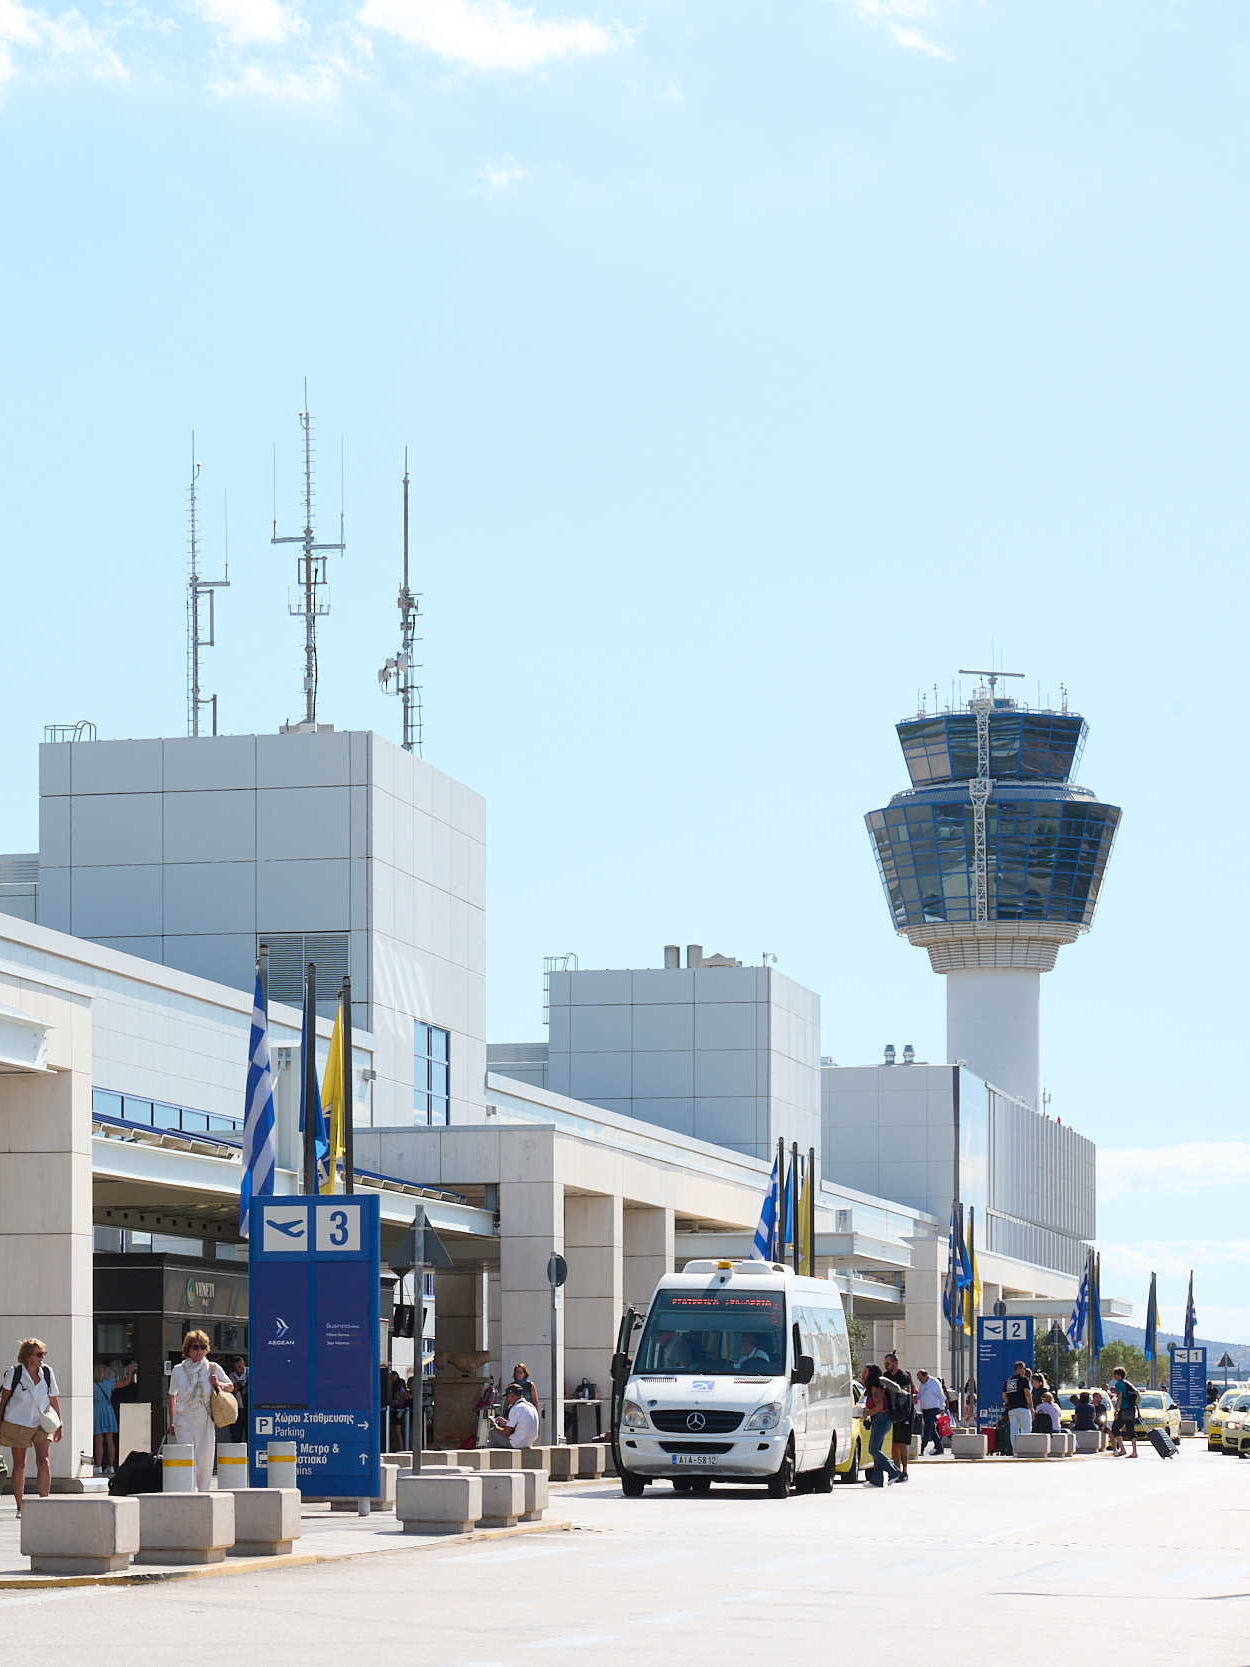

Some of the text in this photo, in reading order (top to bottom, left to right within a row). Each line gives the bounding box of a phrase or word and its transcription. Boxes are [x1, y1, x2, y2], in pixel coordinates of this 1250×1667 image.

[330, 1211, 348, 1246] 3
[195, 1281, 215, 1298] VENETI
[1012, 1323, 1021, 1338] 2
[1194, 1352, 1198, 1361] 1
[274, 1413, 354, 1425] Χώροι Στάθμευσης
[259, 1419, 269, 1432] P
[275, 1427, 305, 1438] Parking
[300, 1443, 329, 1455] Μετρο
[332, 1443, 339, 1453] &
[296, 1454, 327, 1464] στιακό
[679, 1456, 716, 1465] AIA-5812
[296, 1465, 312, 1475] ains
